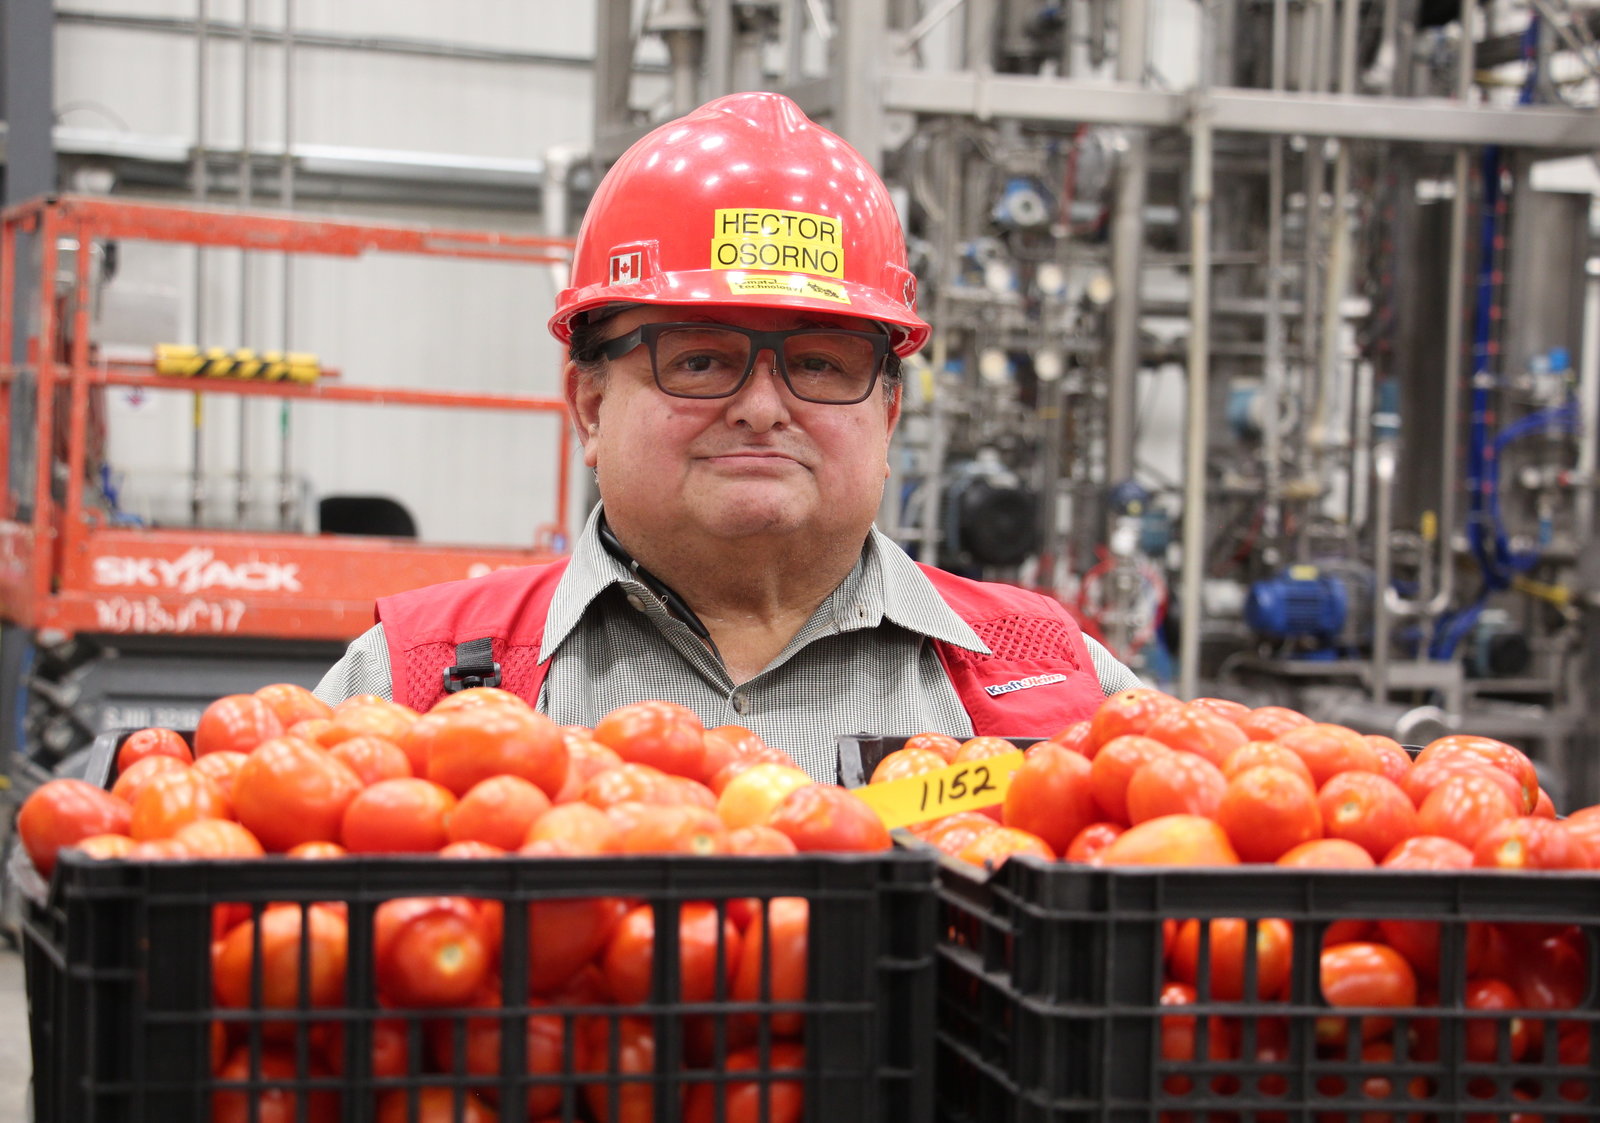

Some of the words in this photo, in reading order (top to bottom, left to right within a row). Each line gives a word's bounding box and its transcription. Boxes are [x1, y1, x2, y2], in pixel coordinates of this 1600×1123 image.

[722, 213, 836, 245] HECTOR
[717, 243, 839, 273] OSORNO
[93, 547, 303, 594] SKYJACK
[920, 766, 997, 812] 1152
